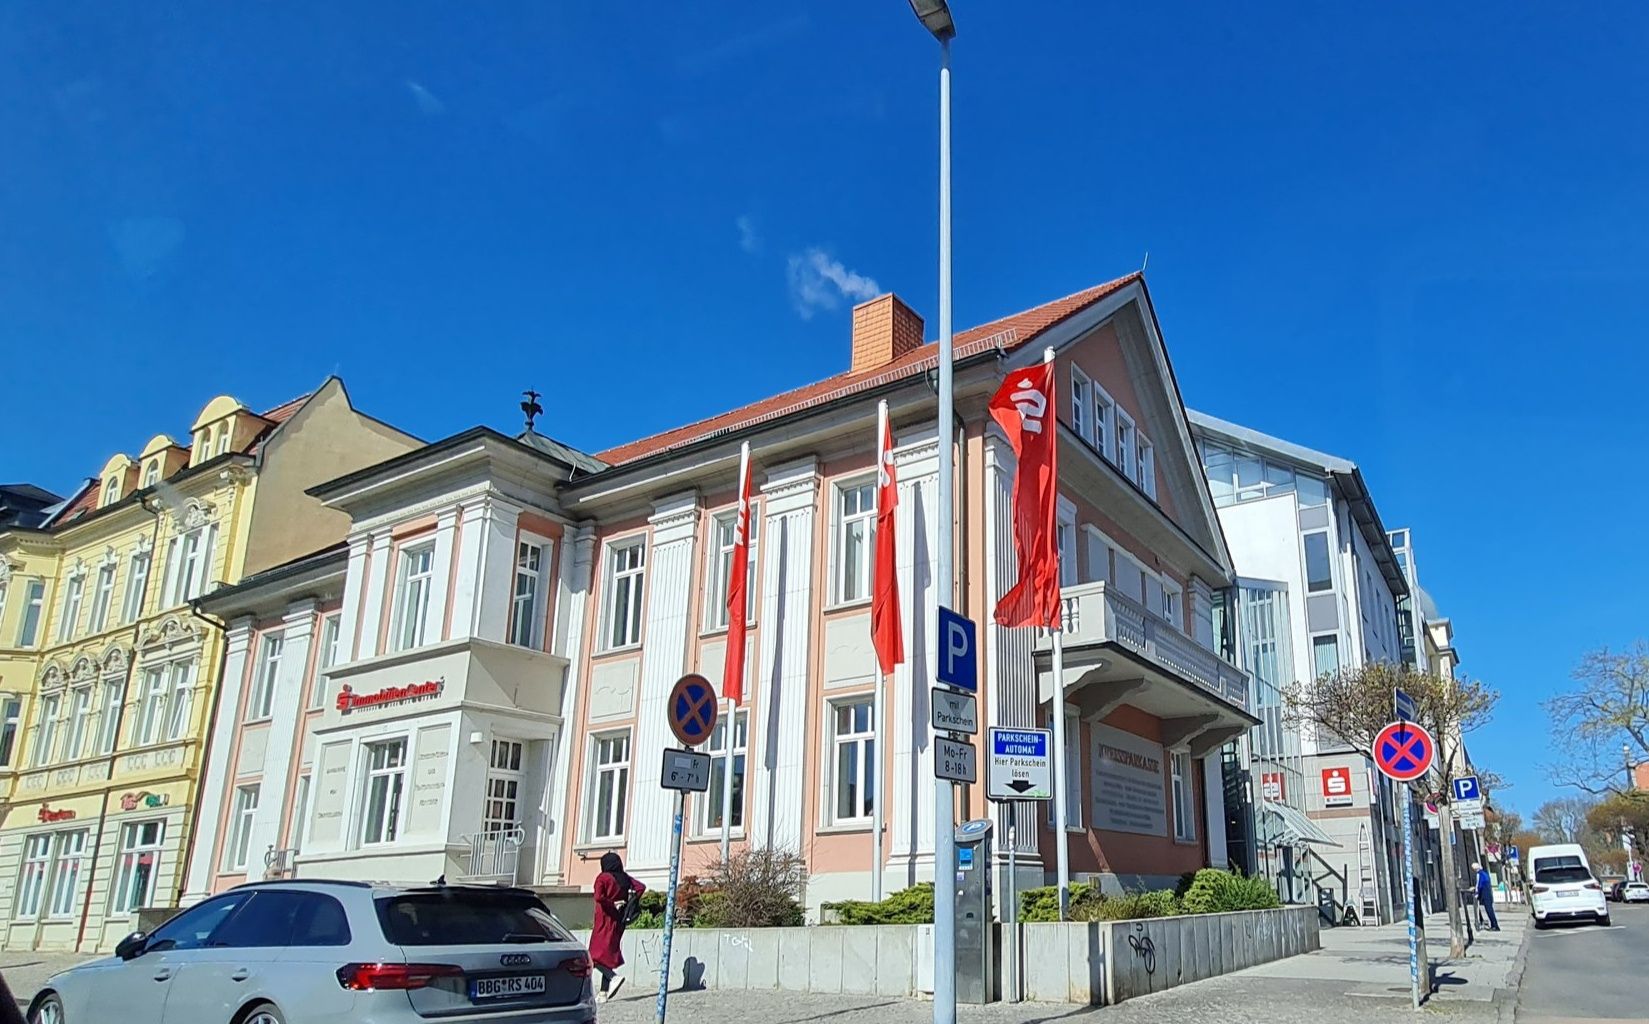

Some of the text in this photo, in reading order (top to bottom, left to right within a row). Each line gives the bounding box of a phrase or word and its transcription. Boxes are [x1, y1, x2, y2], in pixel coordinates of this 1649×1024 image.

[948, 620, 968, 675] P
[937, 711, 973, 726] Parkschein
[998, 733, 1042, 744] PARKSCHEIN-
[1005, 745, 1035, 754] AUTOMAT
[995, 757, 1046, 767] Hier Parkschein
[1012, 769, 1030, 777] lösen
[1459, 780, 1473, 798] P
[478, 977, 545, 996] BBG RS 404
